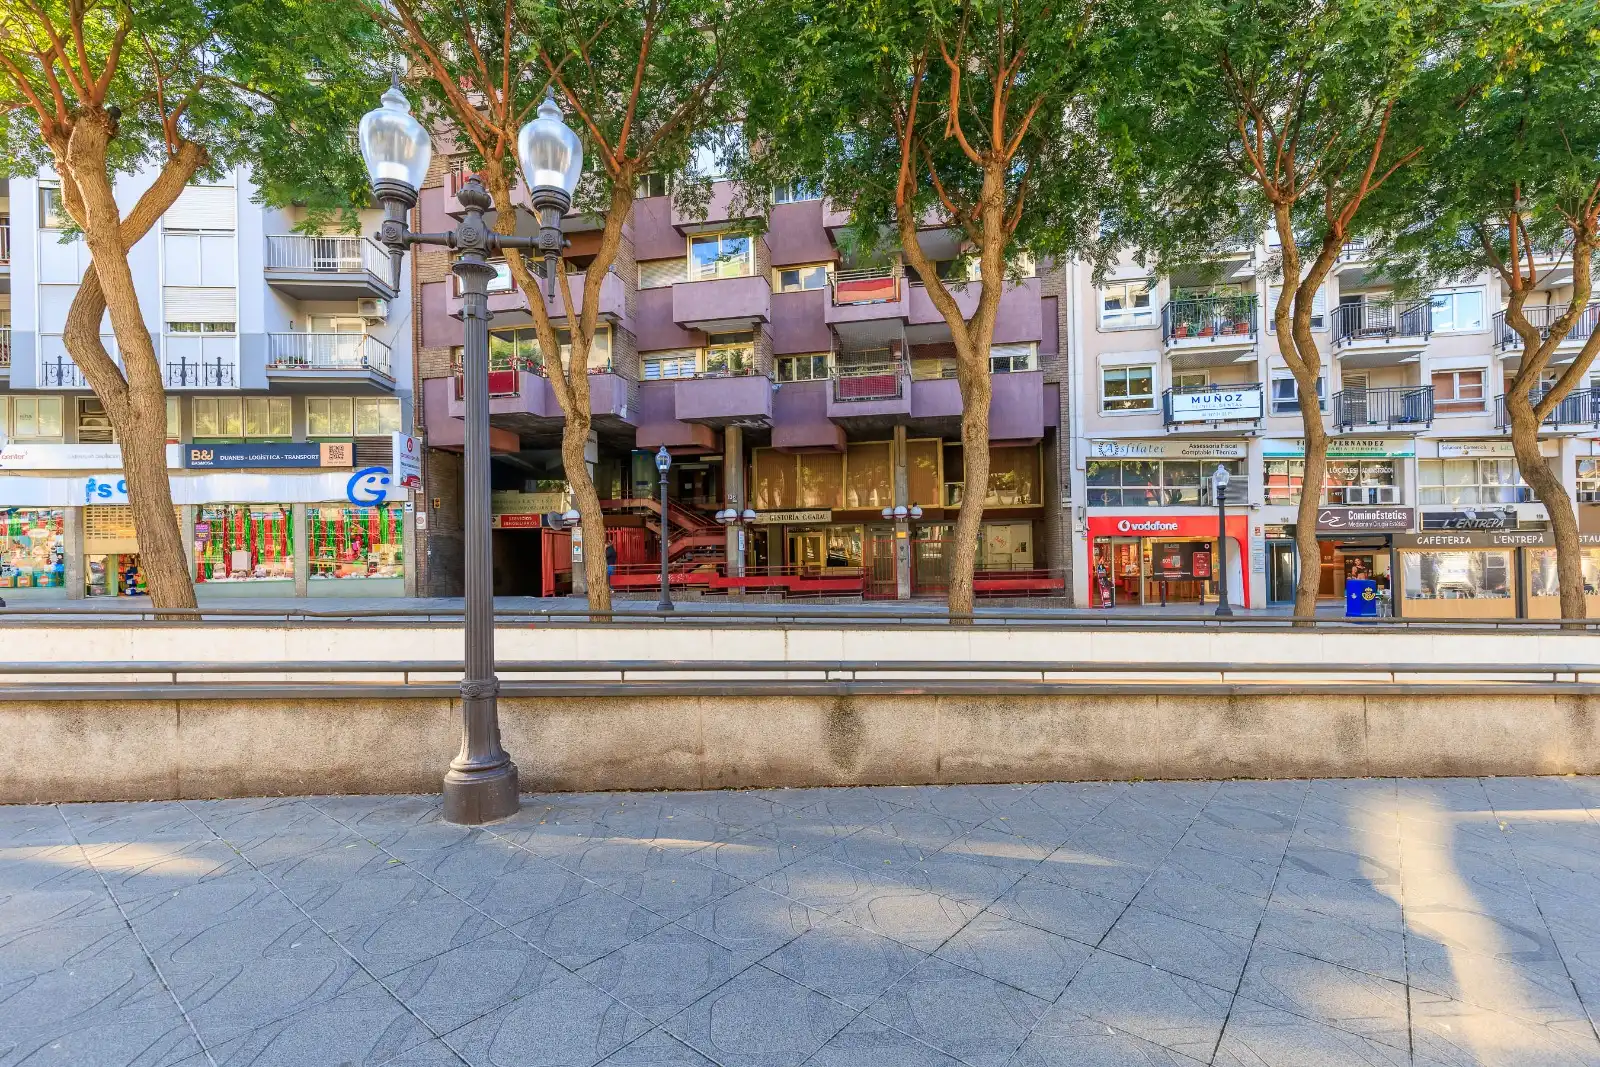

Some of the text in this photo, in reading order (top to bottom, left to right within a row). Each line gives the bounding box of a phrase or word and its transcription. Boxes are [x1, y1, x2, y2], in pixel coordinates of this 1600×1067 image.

[1191, 393, 1243, 404] MUÑOZ
[191, 450, 214, 461] B&J
[769, 512, 799, 521] GESTORIA
[1348, 510, 1407, 520] CominoEstetics
[1131, 521, 1178, 531] vodafone
[1493, 532, 1545, 544] L'ENTREPÀ
